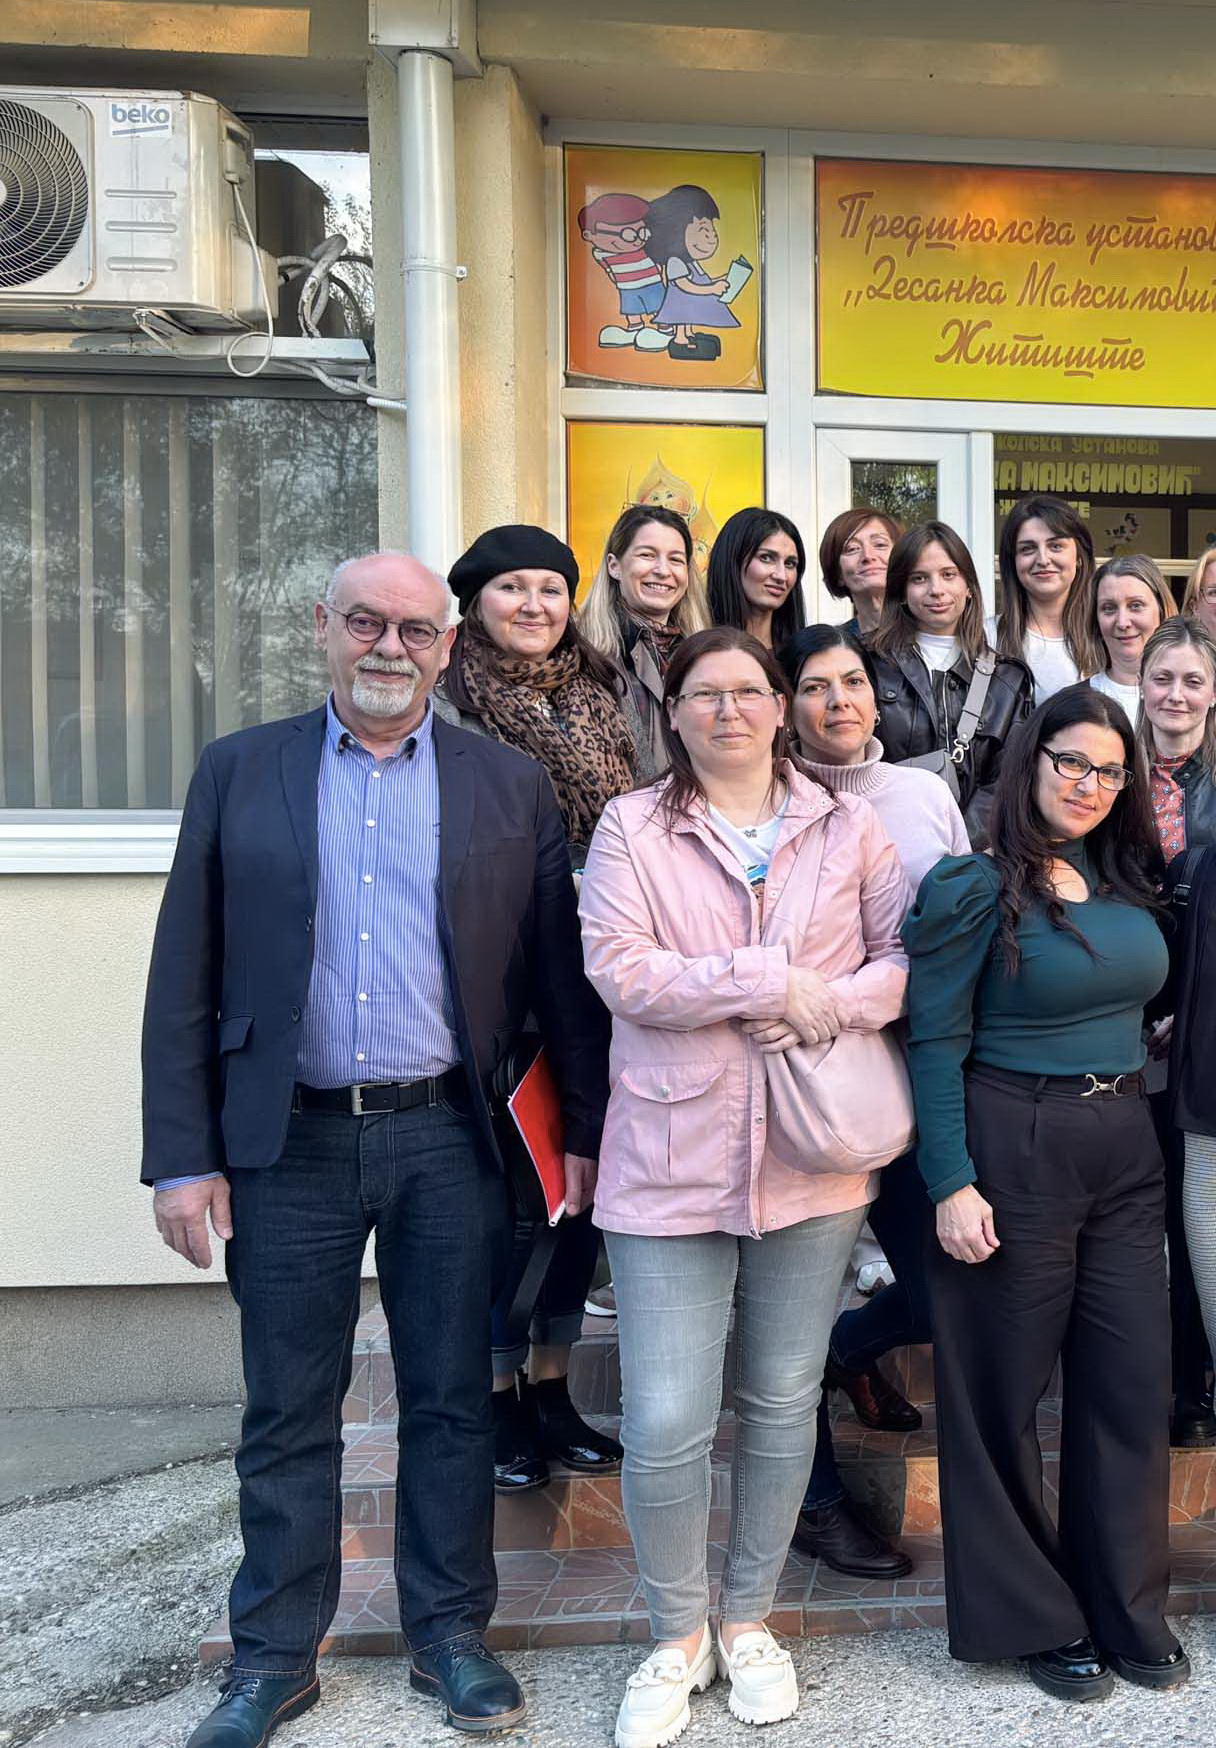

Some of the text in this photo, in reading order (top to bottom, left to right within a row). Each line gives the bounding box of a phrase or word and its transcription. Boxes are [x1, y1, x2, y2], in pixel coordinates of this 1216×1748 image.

[111, 104, 170, 123] beko
[837, 191, 1076, 257] Предшколска
[934, 319, 1146, 379] Житиште
[1071, 437, 1160, 455] УСТАНОВА
